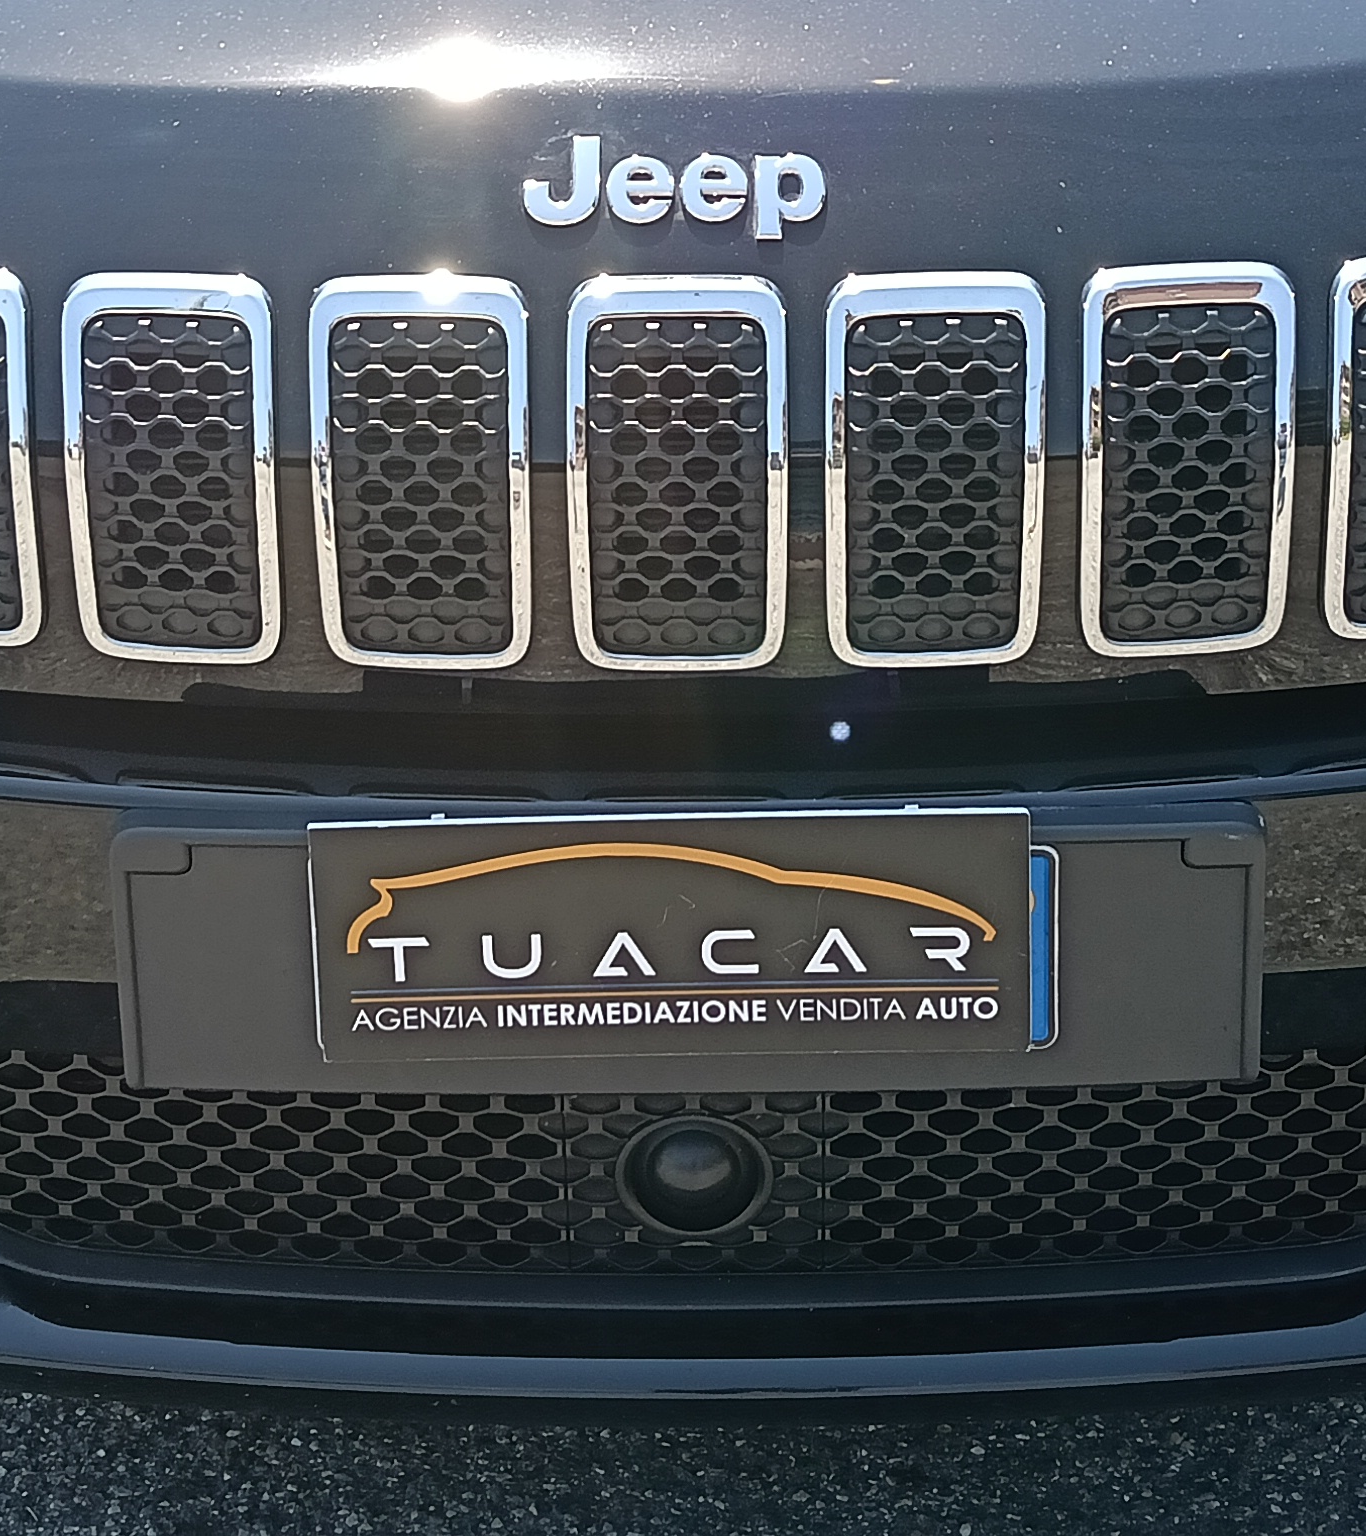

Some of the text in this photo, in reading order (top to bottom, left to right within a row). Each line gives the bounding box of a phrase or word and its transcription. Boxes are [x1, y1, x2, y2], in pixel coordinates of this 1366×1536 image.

[523, 135, 825, 240] Jeep
[367, 927, 971, 982] TUACAR
[352, 995, 999, 1031] AGENZIA INTERMEDIAZIONE VENDITA AUTO
